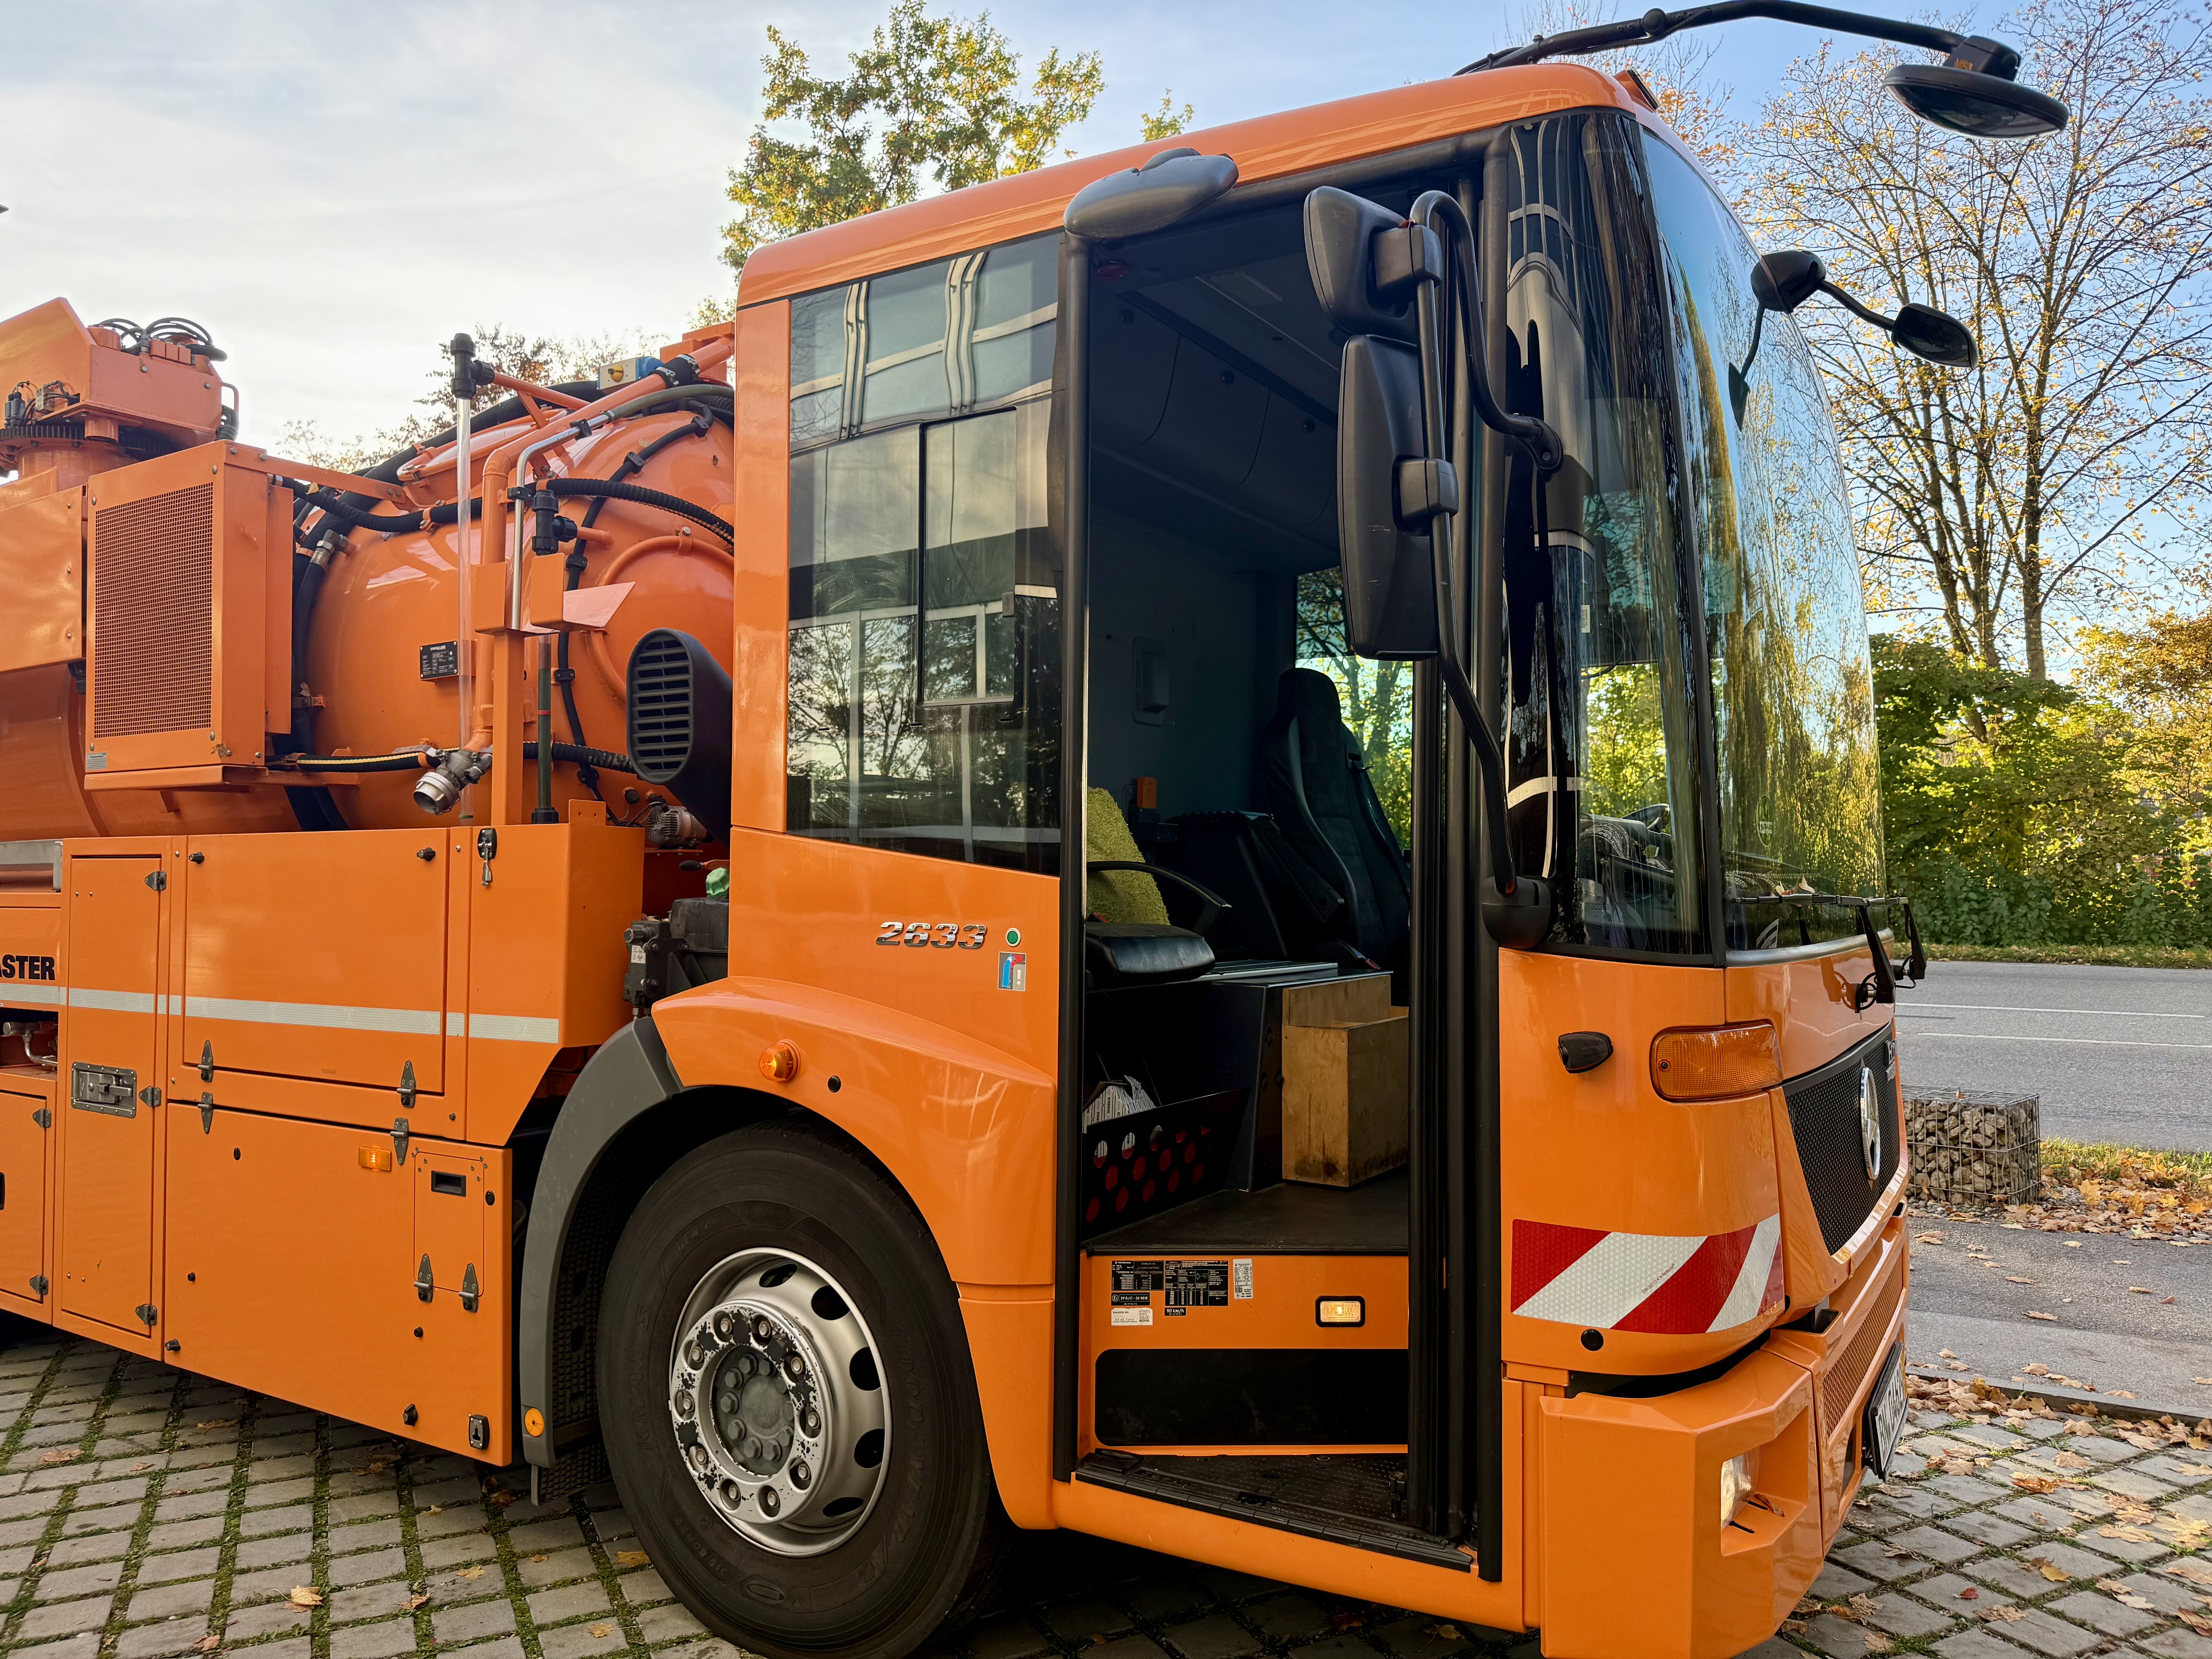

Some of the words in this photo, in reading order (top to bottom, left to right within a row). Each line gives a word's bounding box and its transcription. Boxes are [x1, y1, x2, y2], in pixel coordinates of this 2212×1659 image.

[876, 921, 987, 949] 2633
[0, 955, 55, 980] STER
[1877, 1401, 1890, 1460] BN
[666, 1501, 728, 1578] 315/80R22.5
